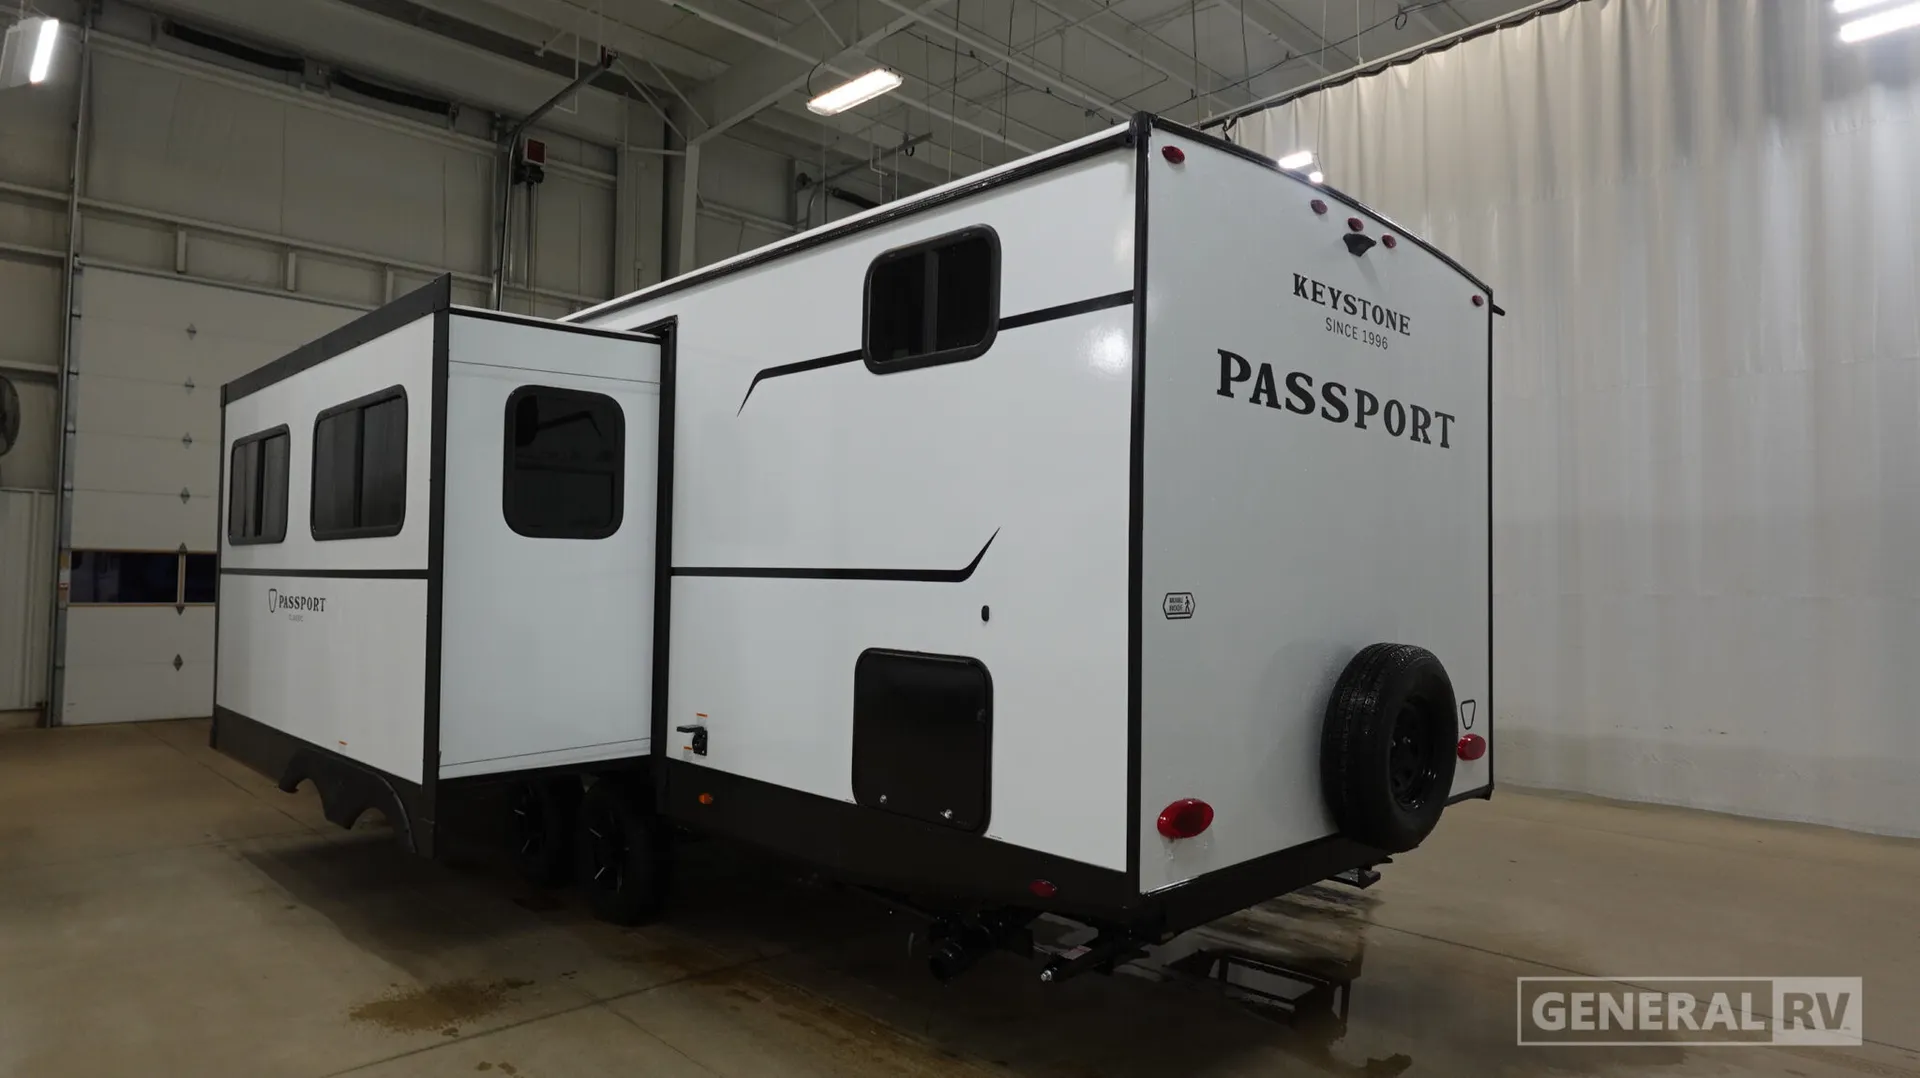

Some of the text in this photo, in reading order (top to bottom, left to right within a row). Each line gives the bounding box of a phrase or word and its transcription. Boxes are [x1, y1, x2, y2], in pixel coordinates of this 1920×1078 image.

[1293, 273, 1411, 336] KEYSTONE
[1325, 317, 1388, 350] SINCE 1996
[1217, 348, 1455, 449] PASSPORT
[278, 594, 326, 612] PASSPORT
